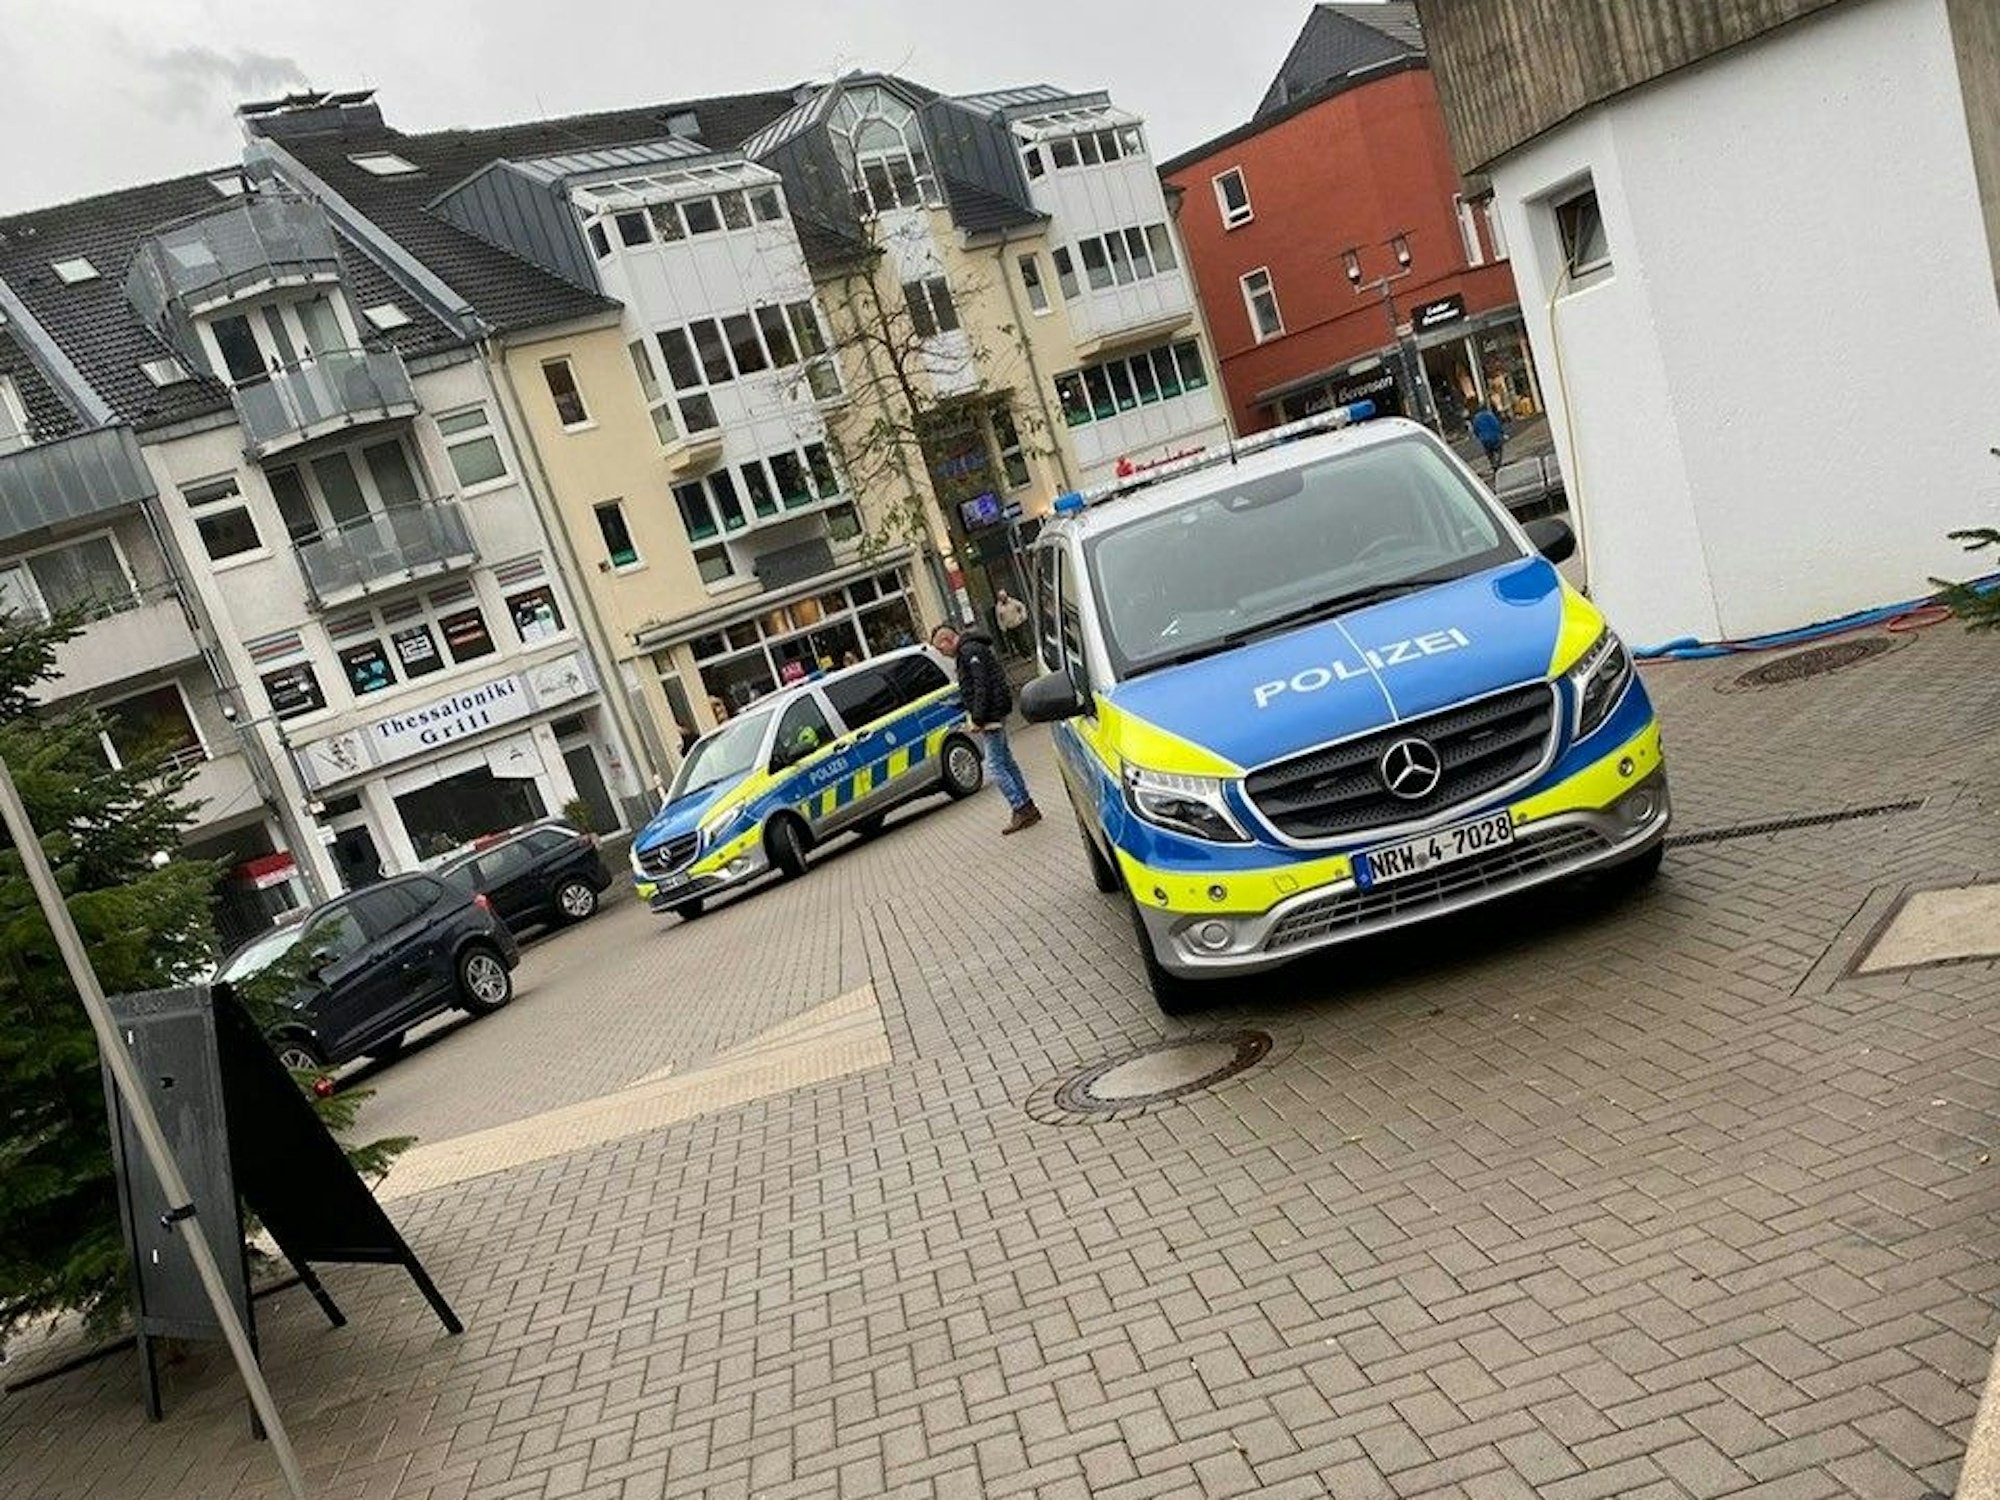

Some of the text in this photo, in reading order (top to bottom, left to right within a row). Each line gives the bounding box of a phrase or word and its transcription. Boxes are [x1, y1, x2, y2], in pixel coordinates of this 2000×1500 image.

[1253, 627, 1470, 709] POLIZEI
[377, 679, 516, 738] Thessaloniki
[420, 711, 490, 744] Grill
[809, 757, 848, 786] POLIZEI
[1369, 846, 1415, 879] NRW
